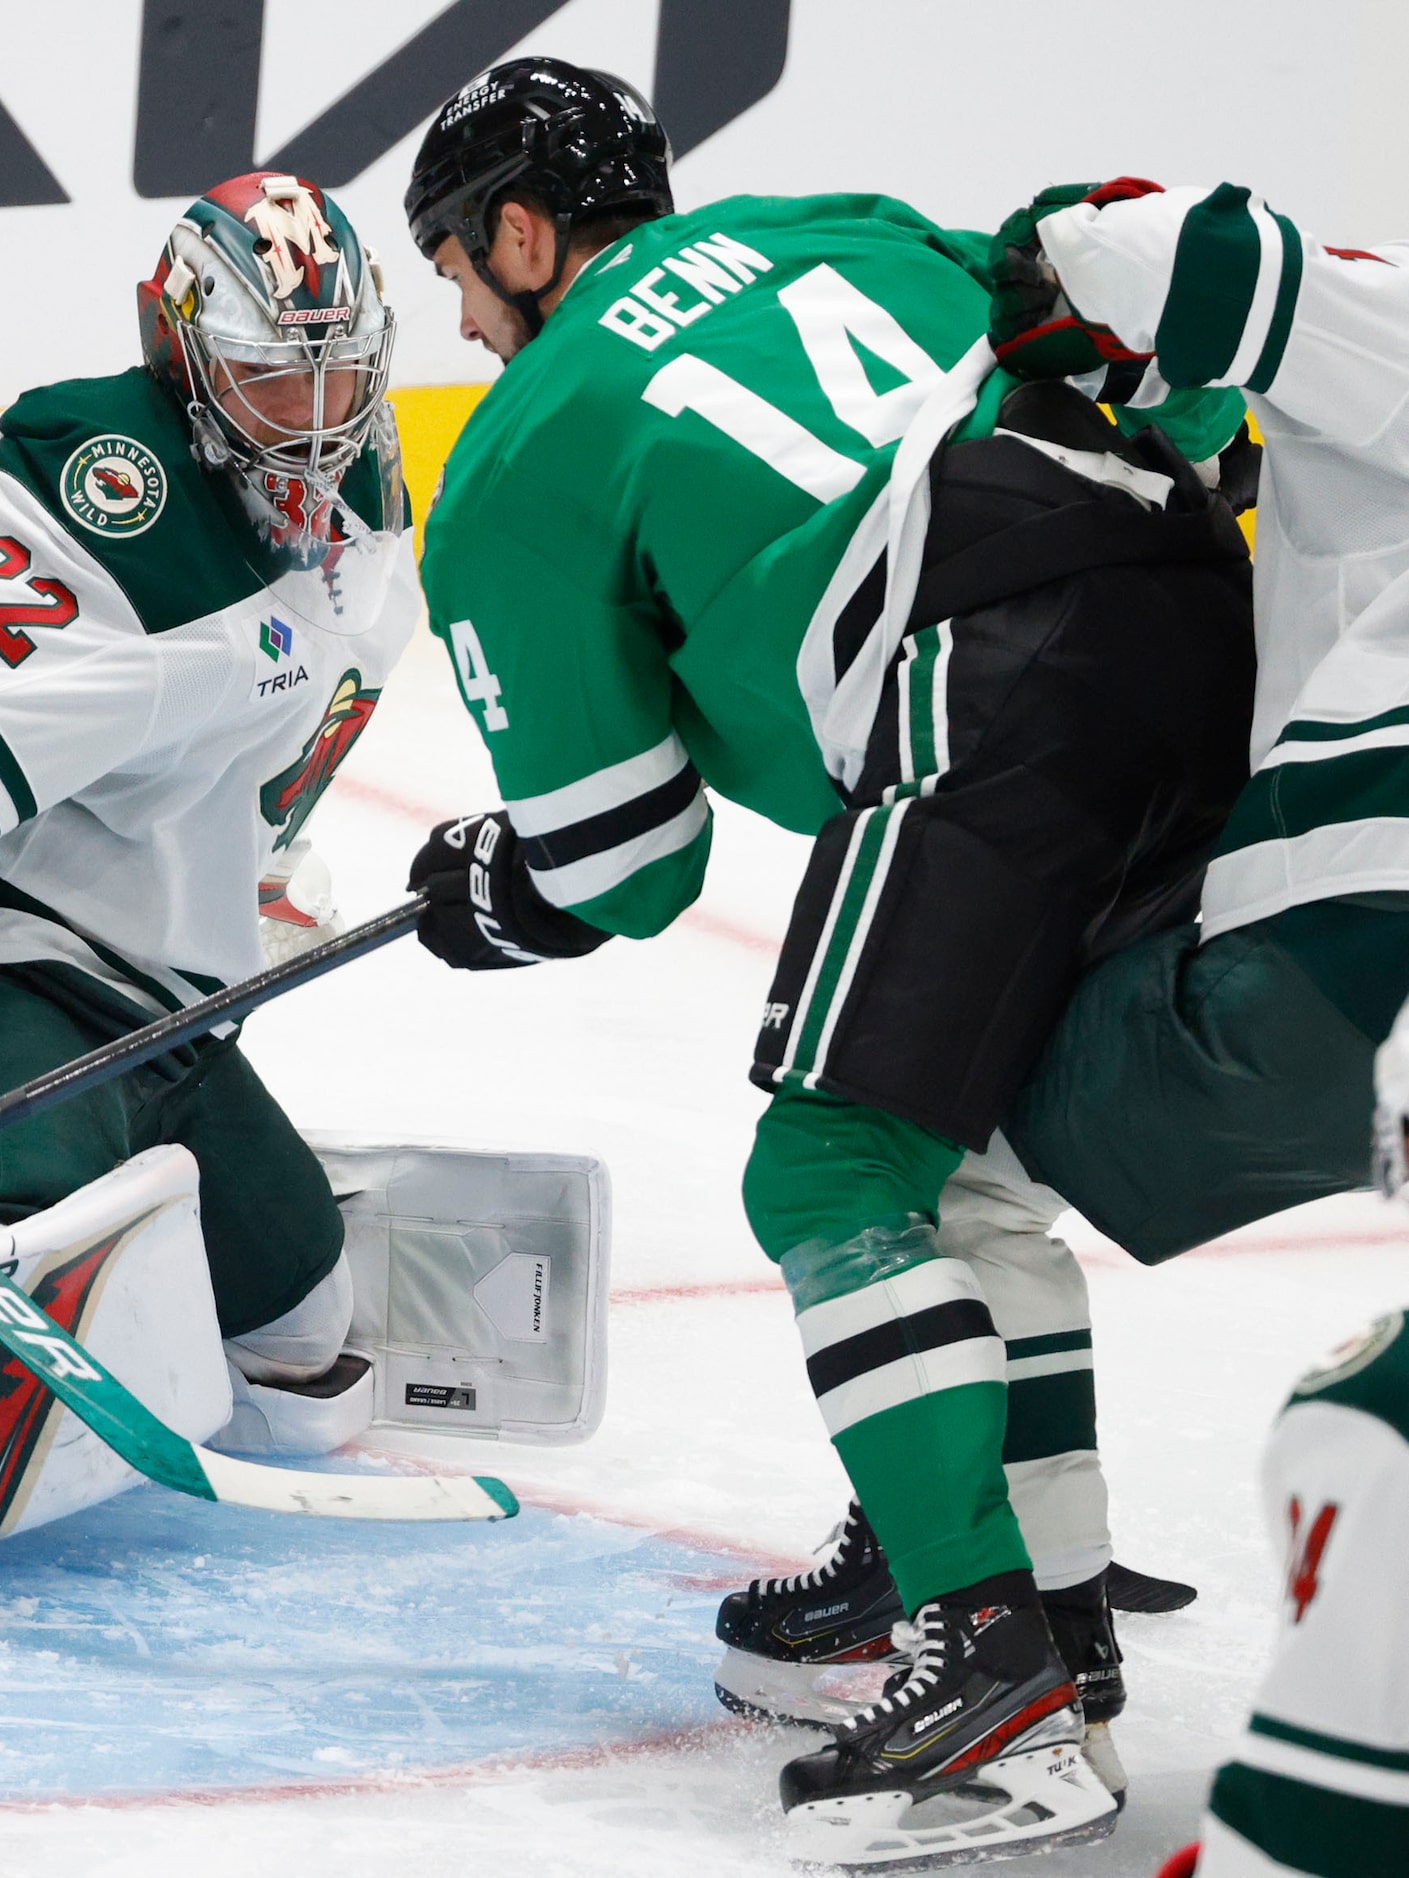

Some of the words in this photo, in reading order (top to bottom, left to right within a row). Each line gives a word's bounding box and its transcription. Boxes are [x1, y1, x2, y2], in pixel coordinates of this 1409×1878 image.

[440, 89, 506, 131] TRANSFER
[446, 80, 499, 117] ENERGY
[597, 231, 775, 353] BENN
[278, 307, 351, 325] BAUER
[639, 261, 948, 506] 14
[91, 441, 160, 509] MINNESOTA
[70, 490, 108, 527] WILD
[257, 665, 309, 697] TRIA
[804, 1602, 850, 1622] BAUER
